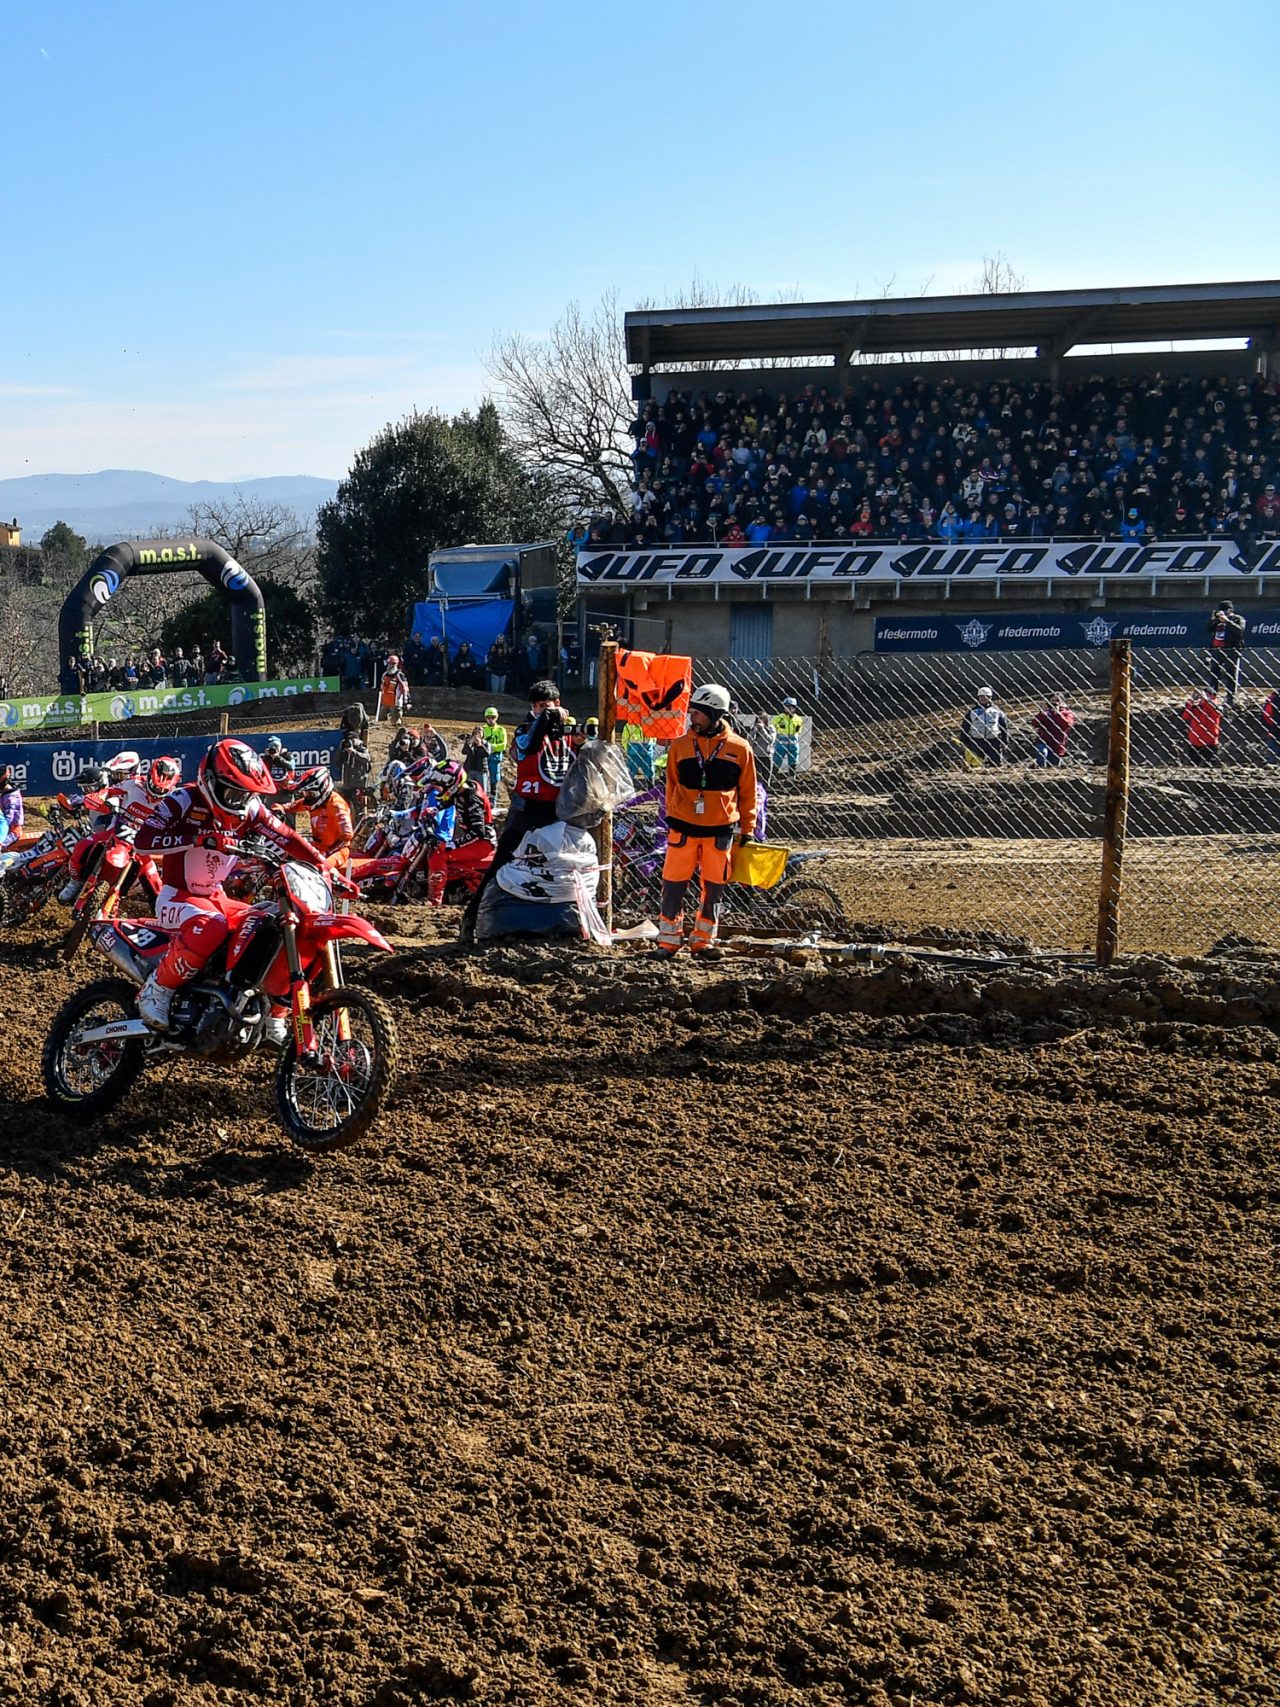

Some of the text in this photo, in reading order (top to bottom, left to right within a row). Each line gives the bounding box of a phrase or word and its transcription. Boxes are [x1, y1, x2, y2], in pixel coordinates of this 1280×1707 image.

[139, 543, 202, 565] m.a.s.t.
[756, 551, 883, 577] UFO
[916, 547, 1049, 575] UFO
[1084, 545, 1222, 573] UFO
[602, 553, 723, 579] UFO
[877, 623, 938, 640] #federmoto
[998, 625, 1061, 638] #federmoto
[1123, 623, 1187, 637] #federmoto
[250, 608, 266, 674] m.a.s.t.
[22, 696, 93, 718] m.a.s.t.
[139, 689, 212, 709] m.a.s.t.
[521, 781, 540, 794] 21
[151, 834, 183, 848] FOX
[160, 905, 187, 925] FOX
